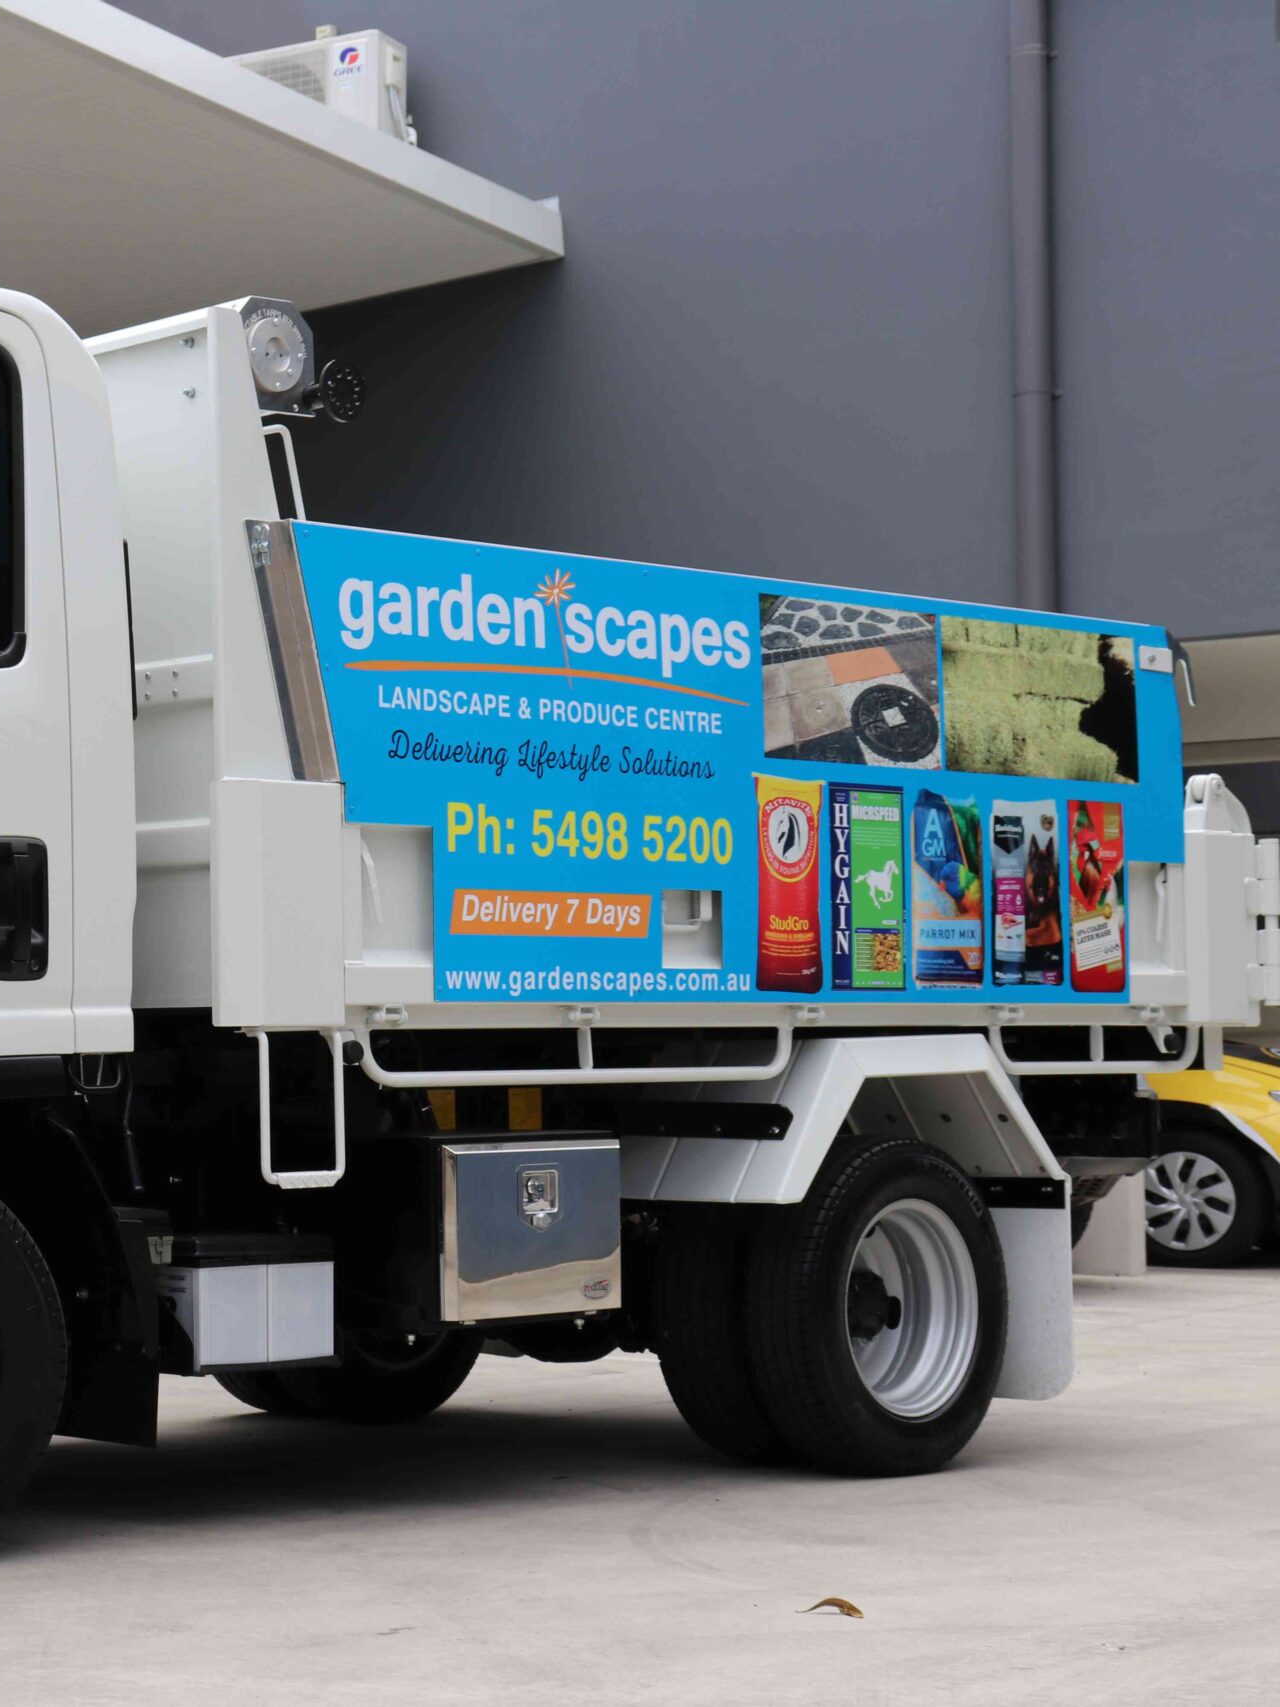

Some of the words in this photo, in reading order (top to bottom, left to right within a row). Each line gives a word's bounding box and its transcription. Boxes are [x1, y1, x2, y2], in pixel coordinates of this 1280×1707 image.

[339, 574, 546, 650] garden
[565, 600, 751, 677] scapes
[378, 685, 511, 718] LANDSCAPE
[518, 698, 531, 719] &
[540, 698, 638, 728] PRODUCE
[646, 708, 722, 734] CENTRE
[388, 730, 508, 777] Delivering
[518, 739, 611, 780] Lifestyle
[619, 747, 715, 779] Solutions
[447, 802, 515, 855] Ph:
[531, 809, 628, 860] 5498
[642, 816, 733, 864] 5200
[462, 895, 558, 930] Delivery
[566, 899, 579, 923] 7
[586, 899, 641, 931] Days
[770, 914, 809, 930] StudGro
[446, 966, 751, 996] www.gardenscapes.com.au
